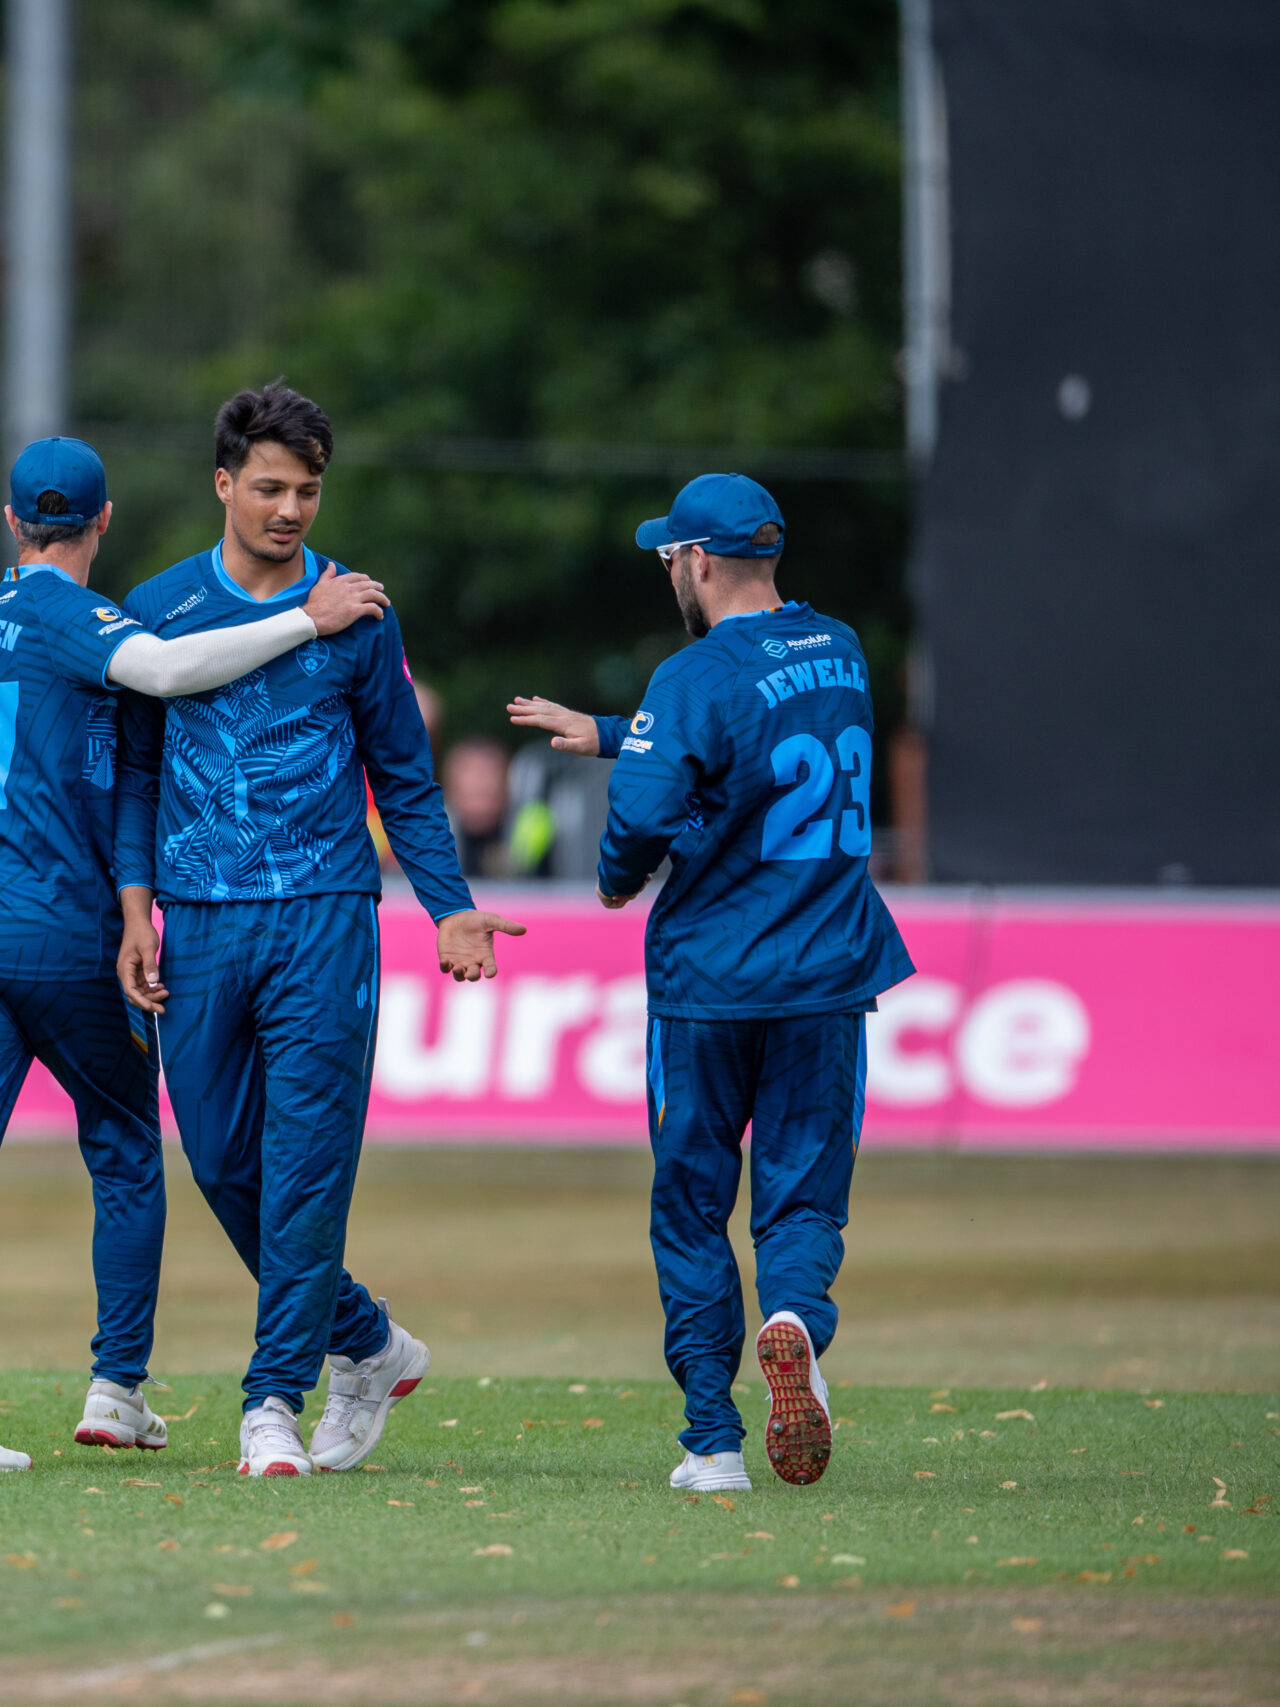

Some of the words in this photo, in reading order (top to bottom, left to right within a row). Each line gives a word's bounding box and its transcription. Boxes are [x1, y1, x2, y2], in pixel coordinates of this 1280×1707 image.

[166, 593, 198, 620] CHEVIN
[755, 658, 865, 710] JEWELL
[760, 725, 873, 862] 23
[373, 970, 1093, 1110] urace
